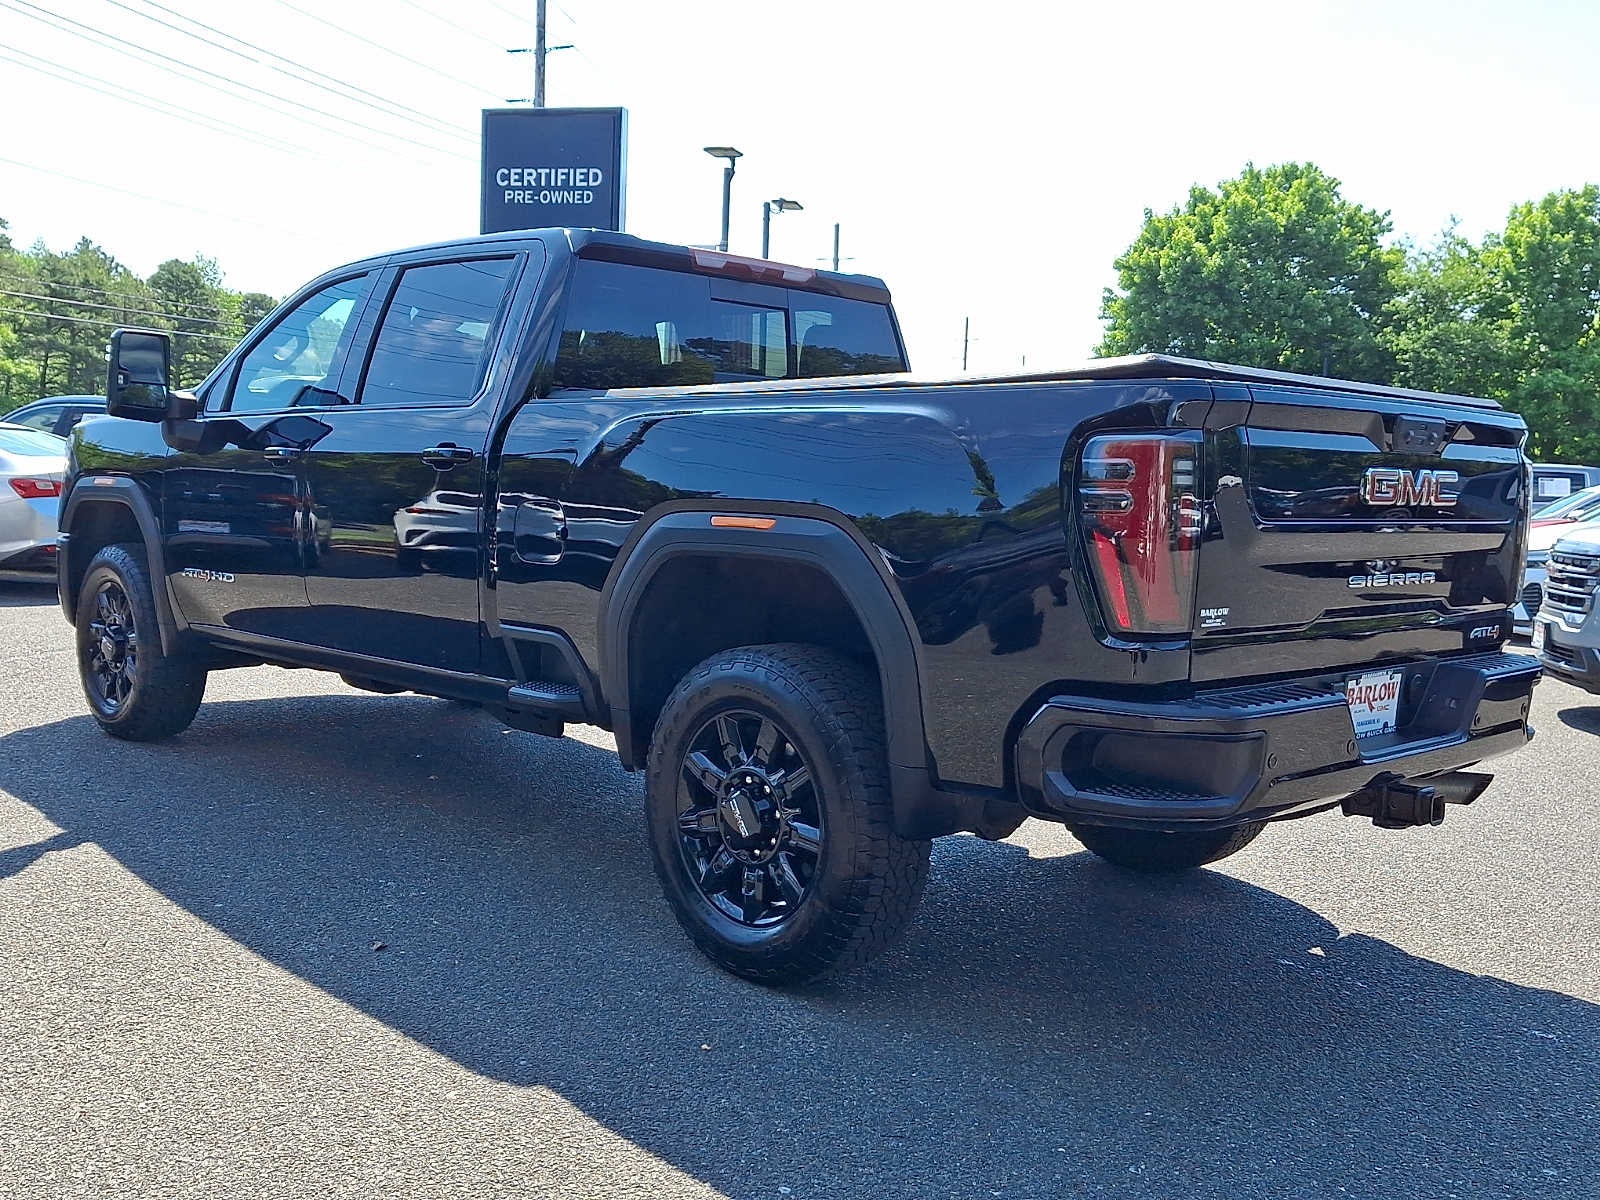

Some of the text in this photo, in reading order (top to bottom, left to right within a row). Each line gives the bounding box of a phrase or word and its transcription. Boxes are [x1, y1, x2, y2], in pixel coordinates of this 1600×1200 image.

[496, 167, 603, 187] CERTIFIED
[504, 190, 593, 204] PRE-OWNED
[1364, 467, 1459, 507] GMC
[1348, 572, 1436, 588] SIERRA
[1200, 607, 1230, 618] BARLOW
[1470, 625, 1500, 639] AT4
[1347, 681, 1399, 713] BARLOW
